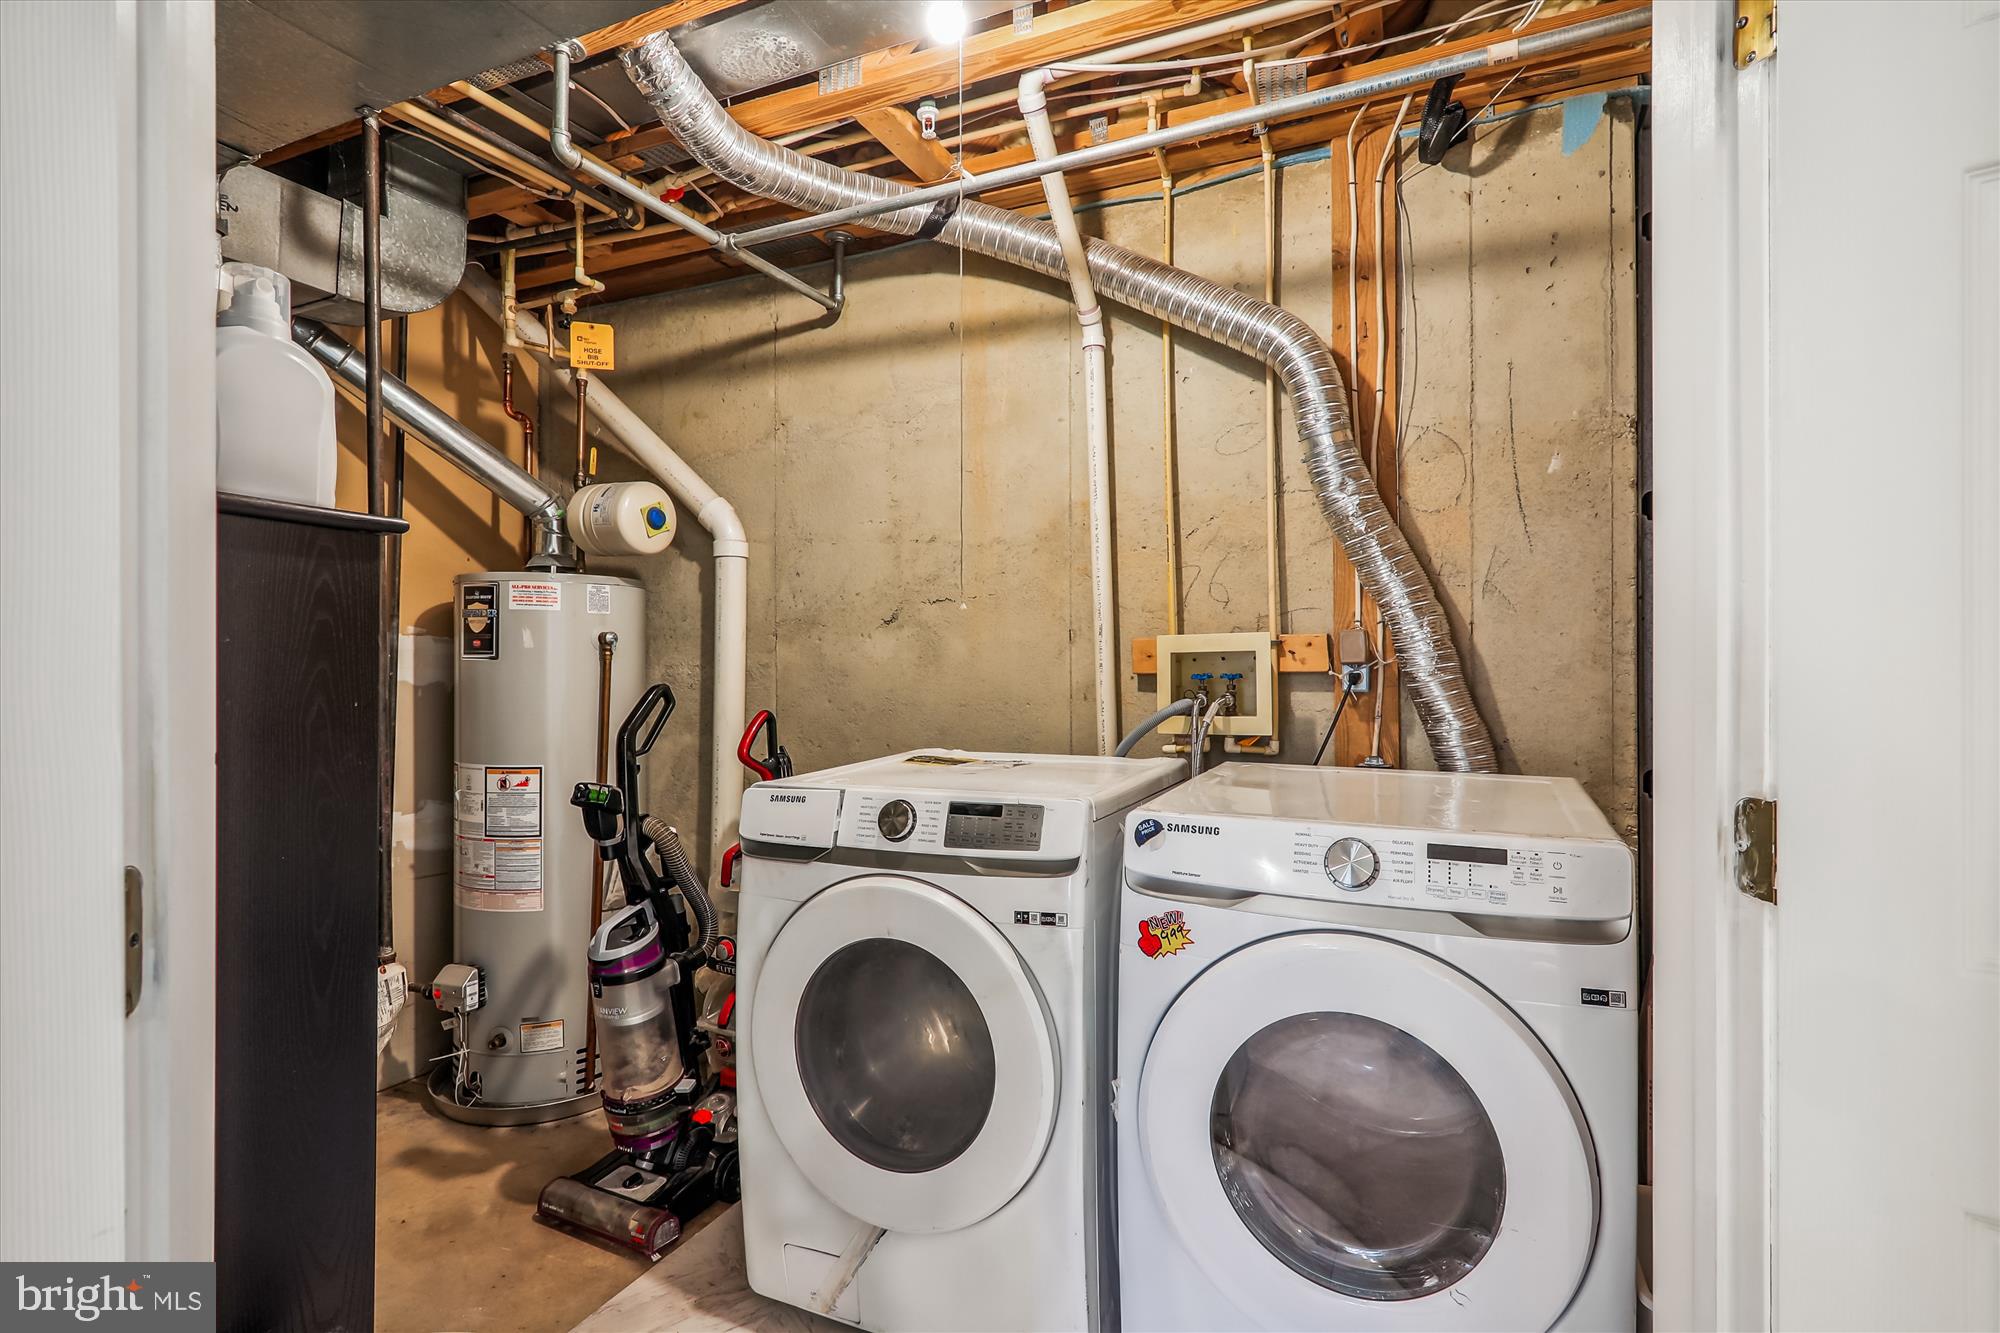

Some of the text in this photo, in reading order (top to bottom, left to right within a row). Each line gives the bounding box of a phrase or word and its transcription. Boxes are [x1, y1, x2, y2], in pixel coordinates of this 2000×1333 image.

[769, 794, 807, 804] SAMSUNG
[1138, 820, 1155, 831] SALE
[1141, 826, 1155, 835] PRICE
[1167, 823, 1220, 836] SAMSUNG
[1147, 911, 1184, 932] NEW!
[1160, 925, 1185, 945] 999
[716, 964, 736, 975] ELITE
